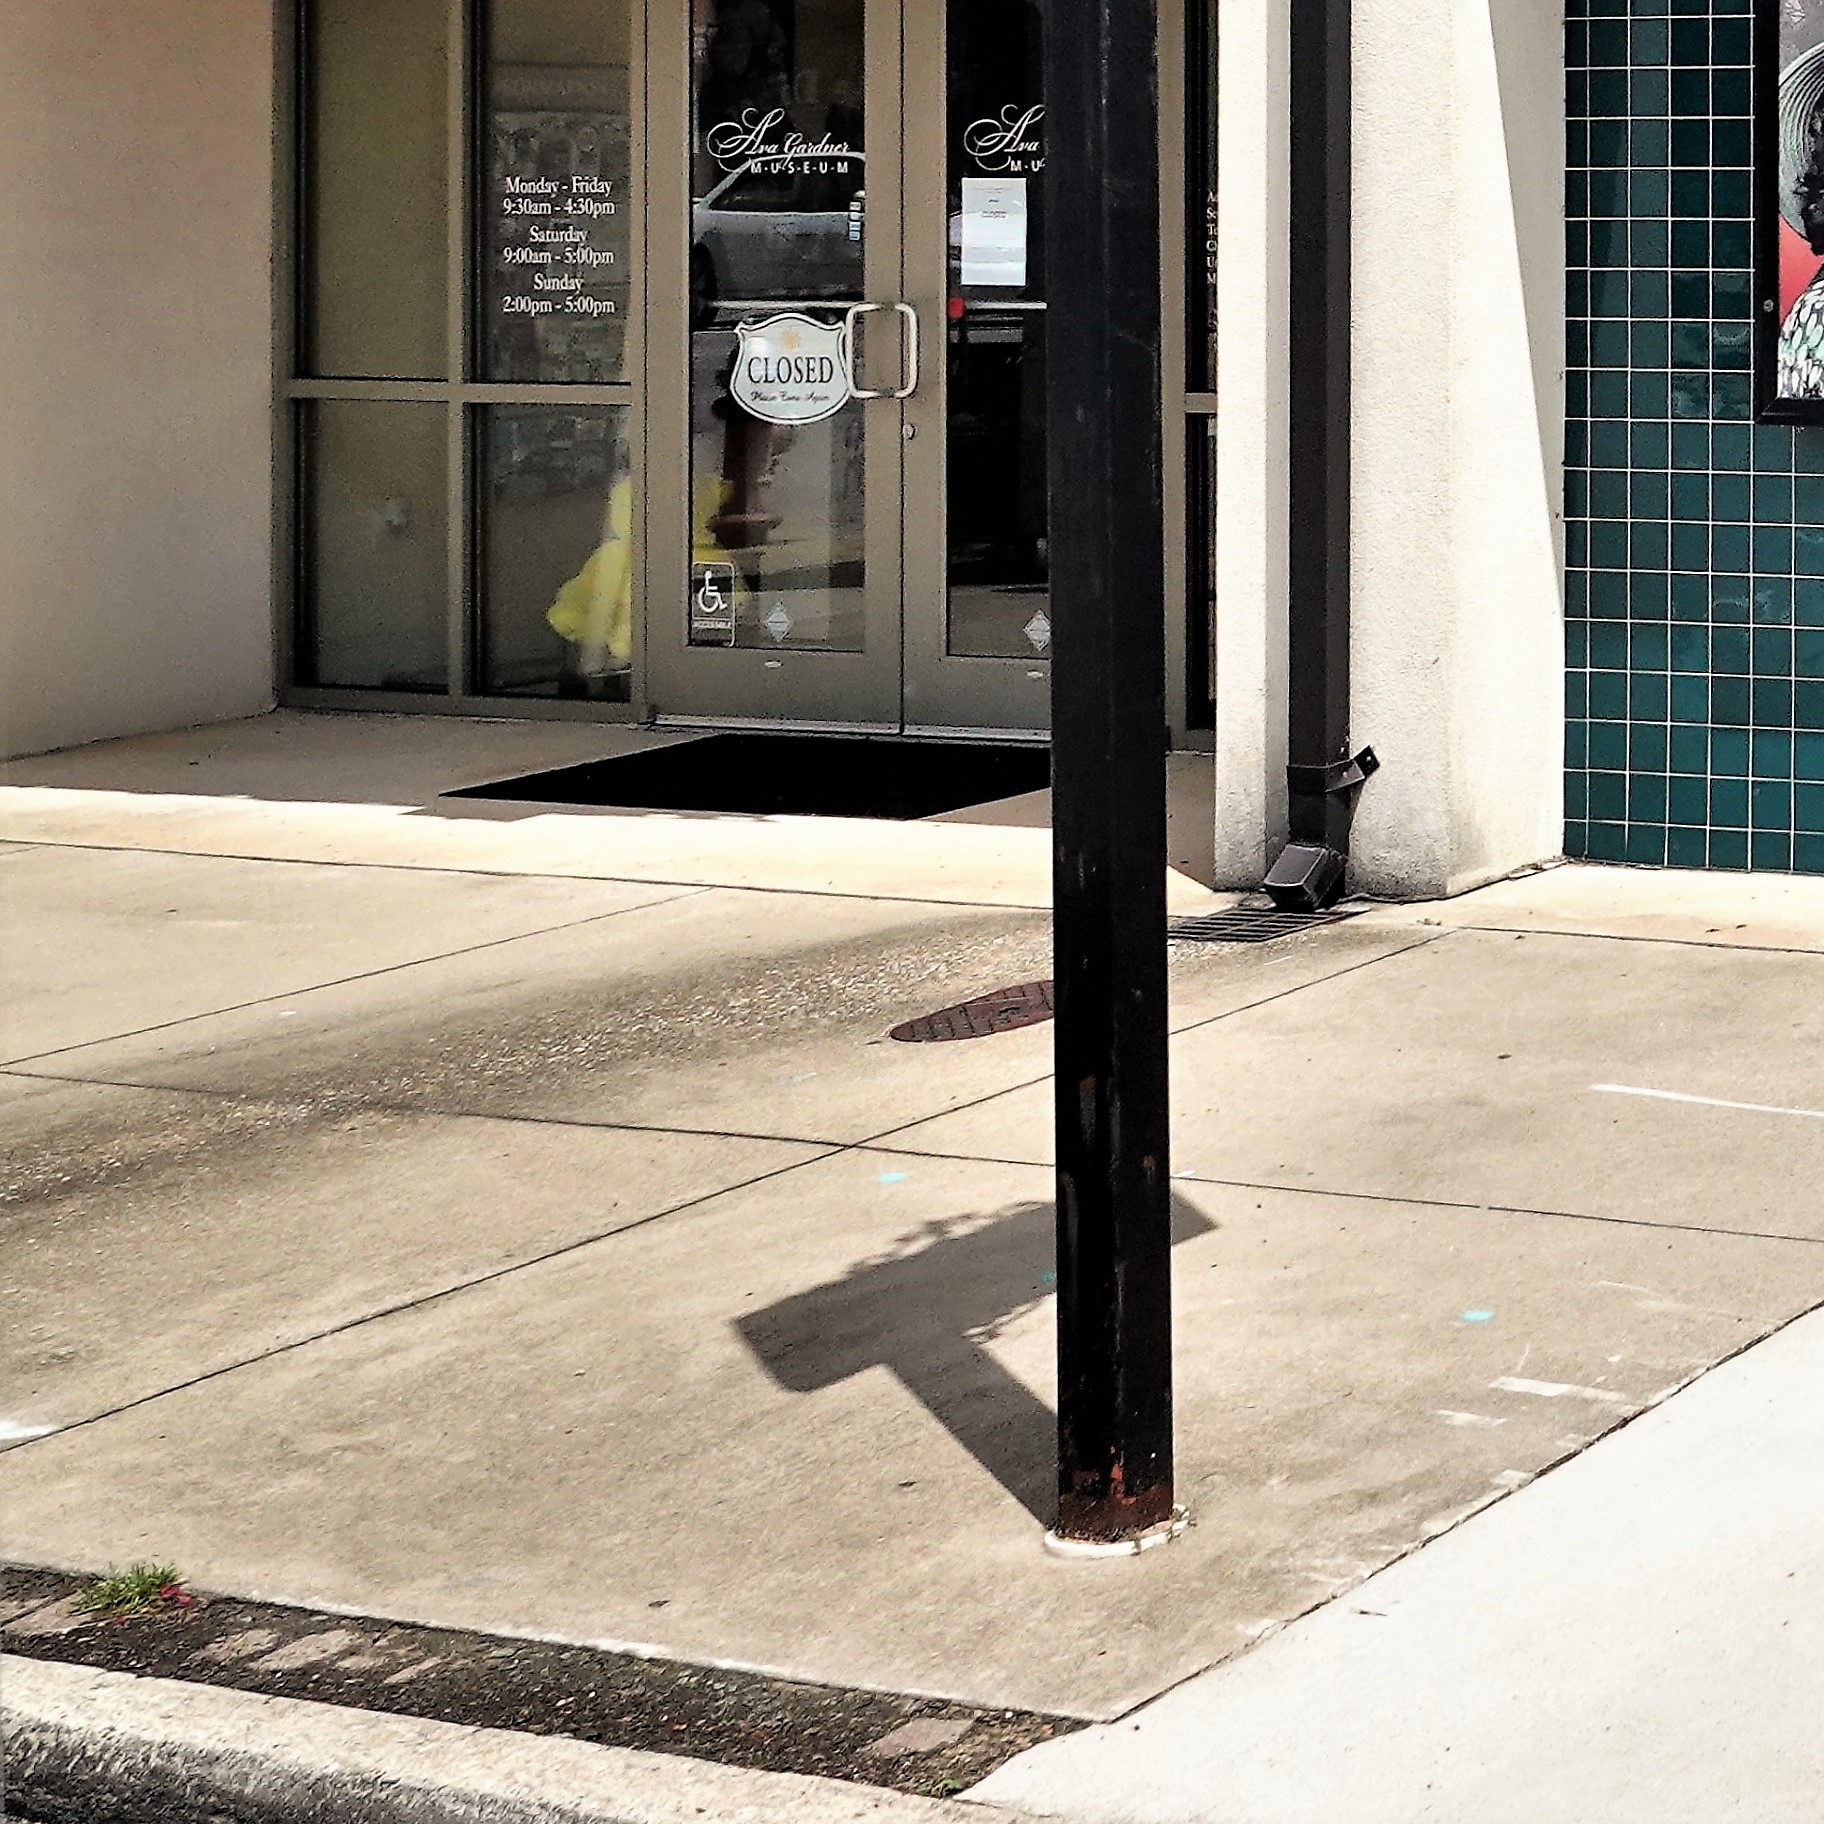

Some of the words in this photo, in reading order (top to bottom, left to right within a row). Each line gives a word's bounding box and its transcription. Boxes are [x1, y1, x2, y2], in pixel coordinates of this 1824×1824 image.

[707, 107, 784, 172] Ava
[784, 132, 850, 169] Gardner
[505, 176, 560, 198] Monday
[571, 176, 613, 197] Friday
[503, 198, 552, 215] 9:30am
[563, 198, 616, 218] 4:30pm
[529, 225, 589, 246] Saturday
[503, 247, 552, 264] 9:00am
[563, 247, 615, 268] 5:00pm
[533, 273, 585, 294] Sunday
[502, 295, 553, 317] 2:00pm
[563, 295, 616, 317] 5:00pm
[747, 356, 834, 384] CLOSED
